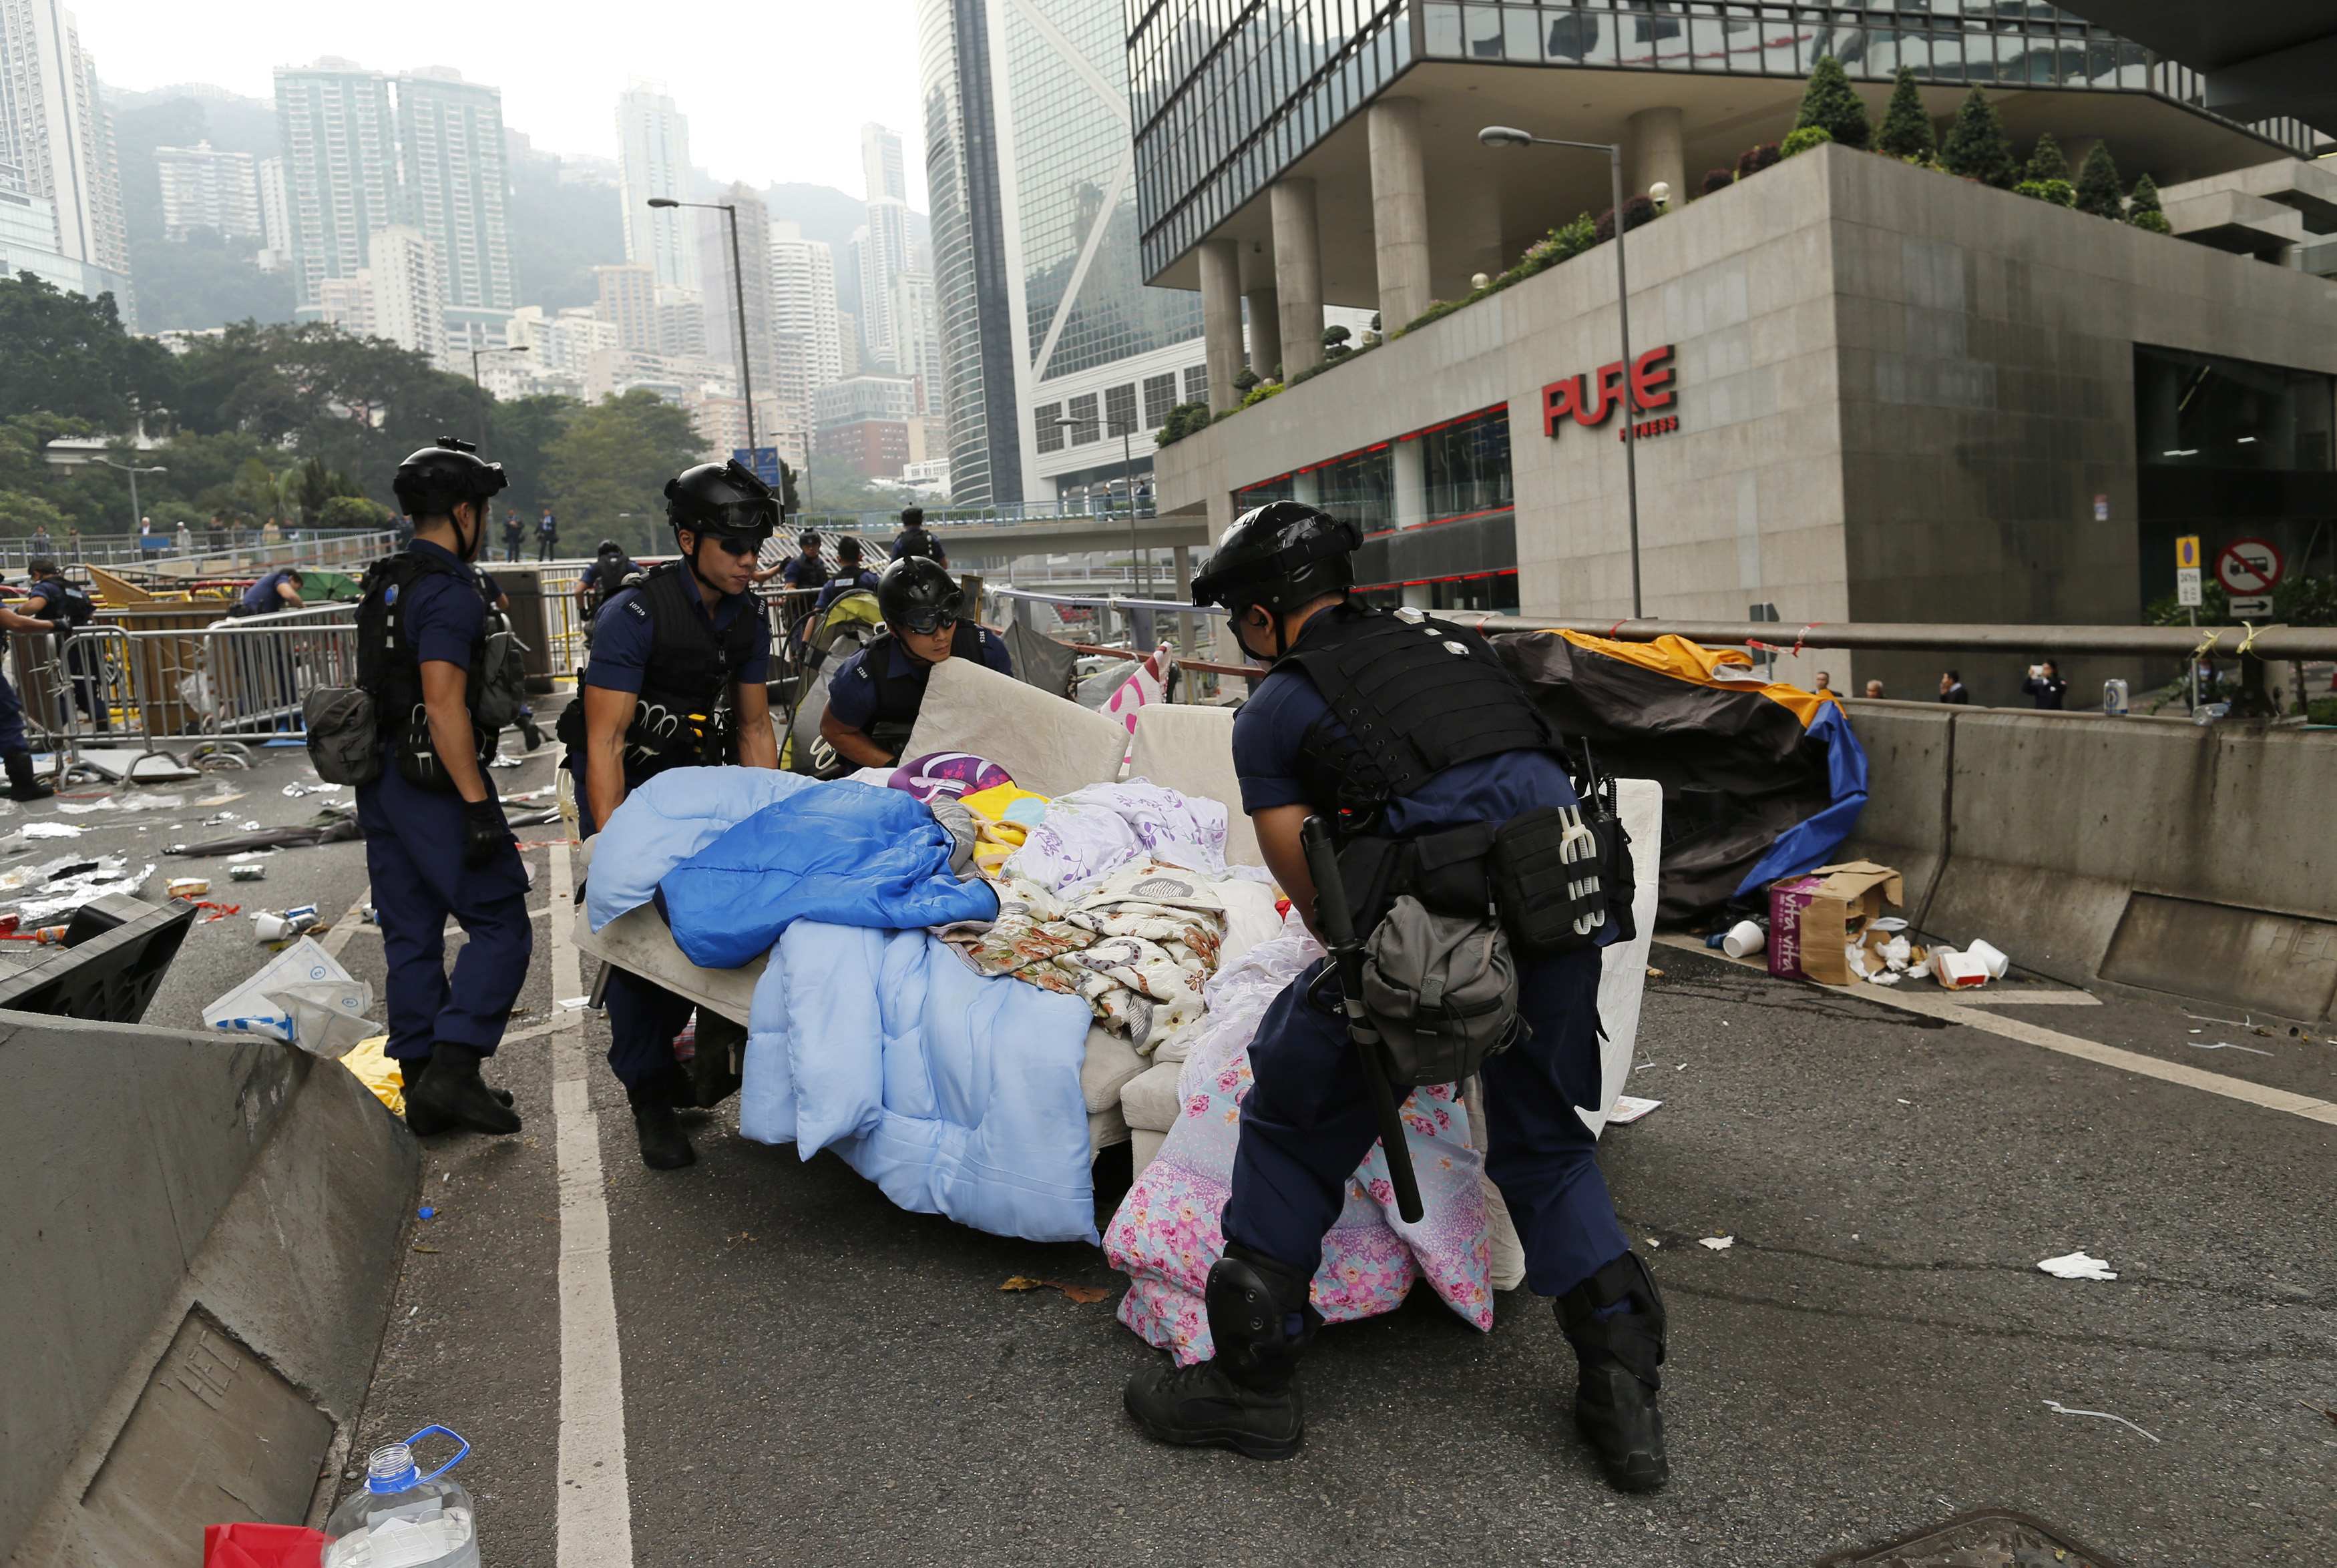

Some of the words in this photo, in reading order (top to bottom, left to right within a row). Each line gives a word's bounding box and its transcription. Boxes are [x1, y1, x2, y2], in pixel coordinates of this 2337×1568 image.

[1542, 344, 1672, 438] PURE
[1619, 415, 1677, 442] FTNESS
[629, 601, 646, 615] 10739
[1783, 893, 1802, 931] vita
[1781, 935, 1800, 971] vita
